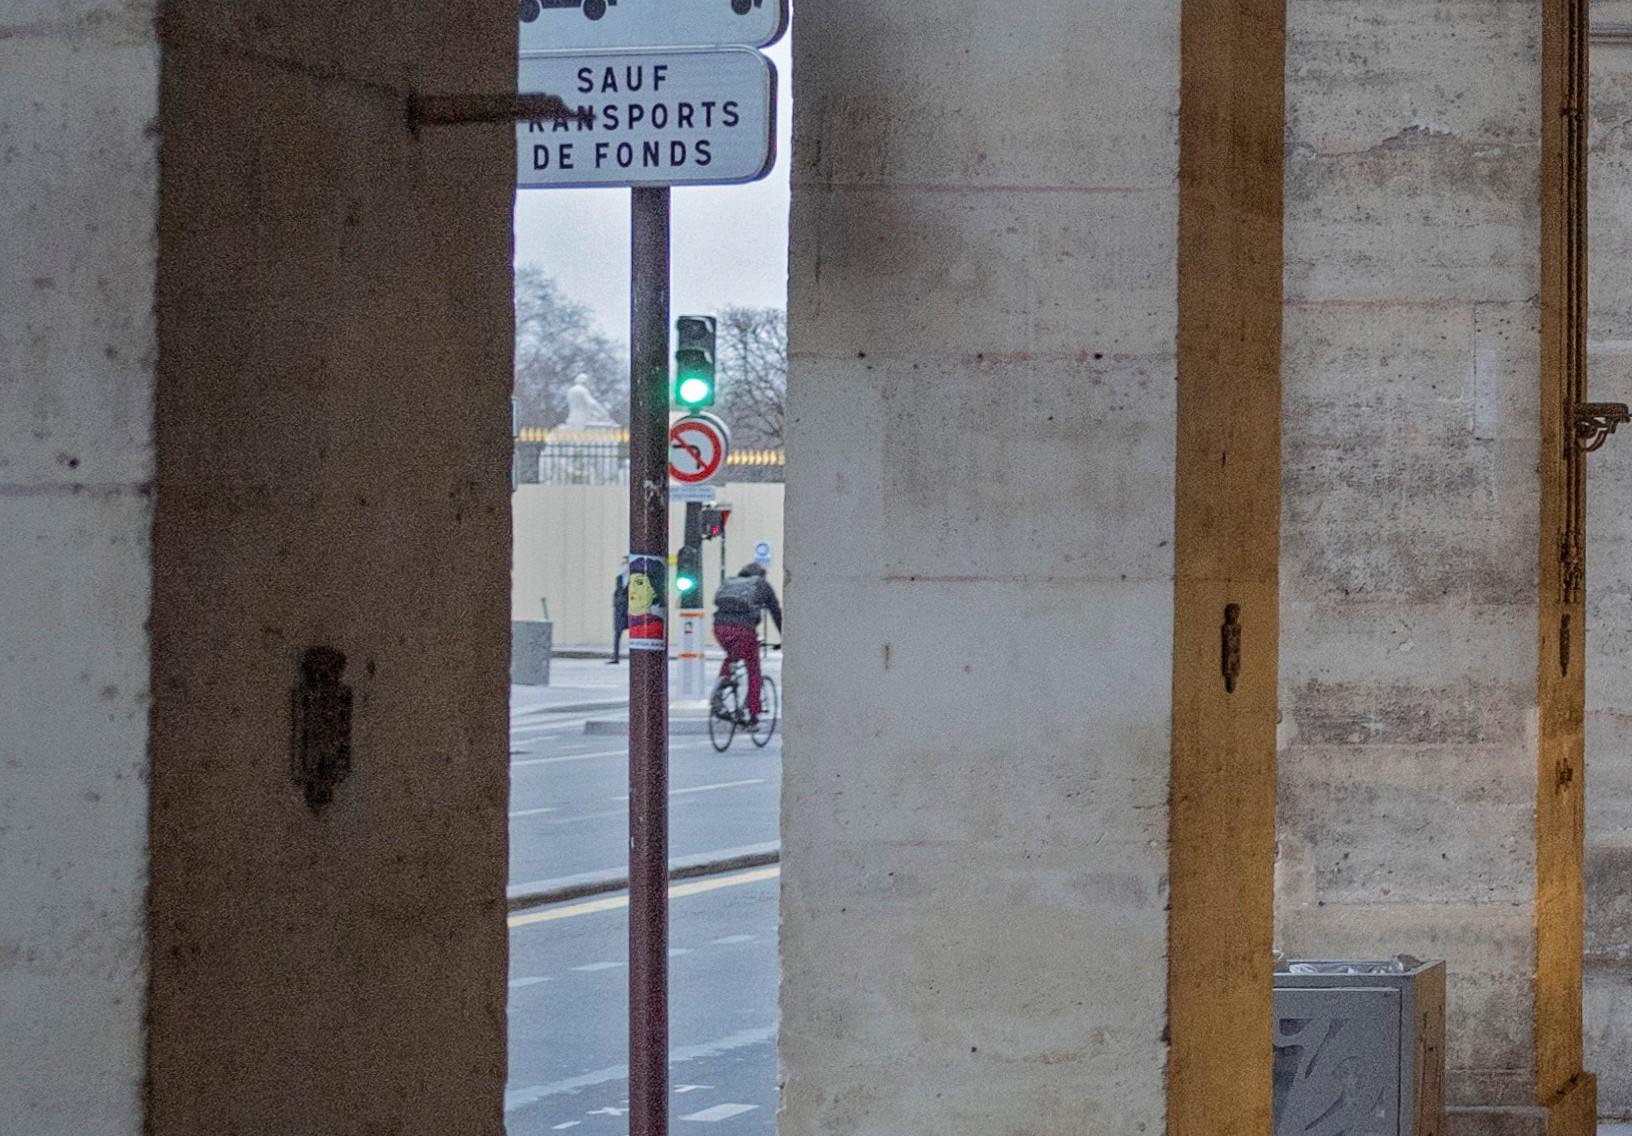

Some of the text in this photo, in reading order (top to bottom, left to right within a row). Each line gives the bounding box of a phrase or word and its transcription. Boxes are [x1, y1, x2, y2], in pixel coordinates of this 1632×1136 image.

[577, 65, 669, 93] SAUF
[533, 140, 713, 171] DE FONDS
